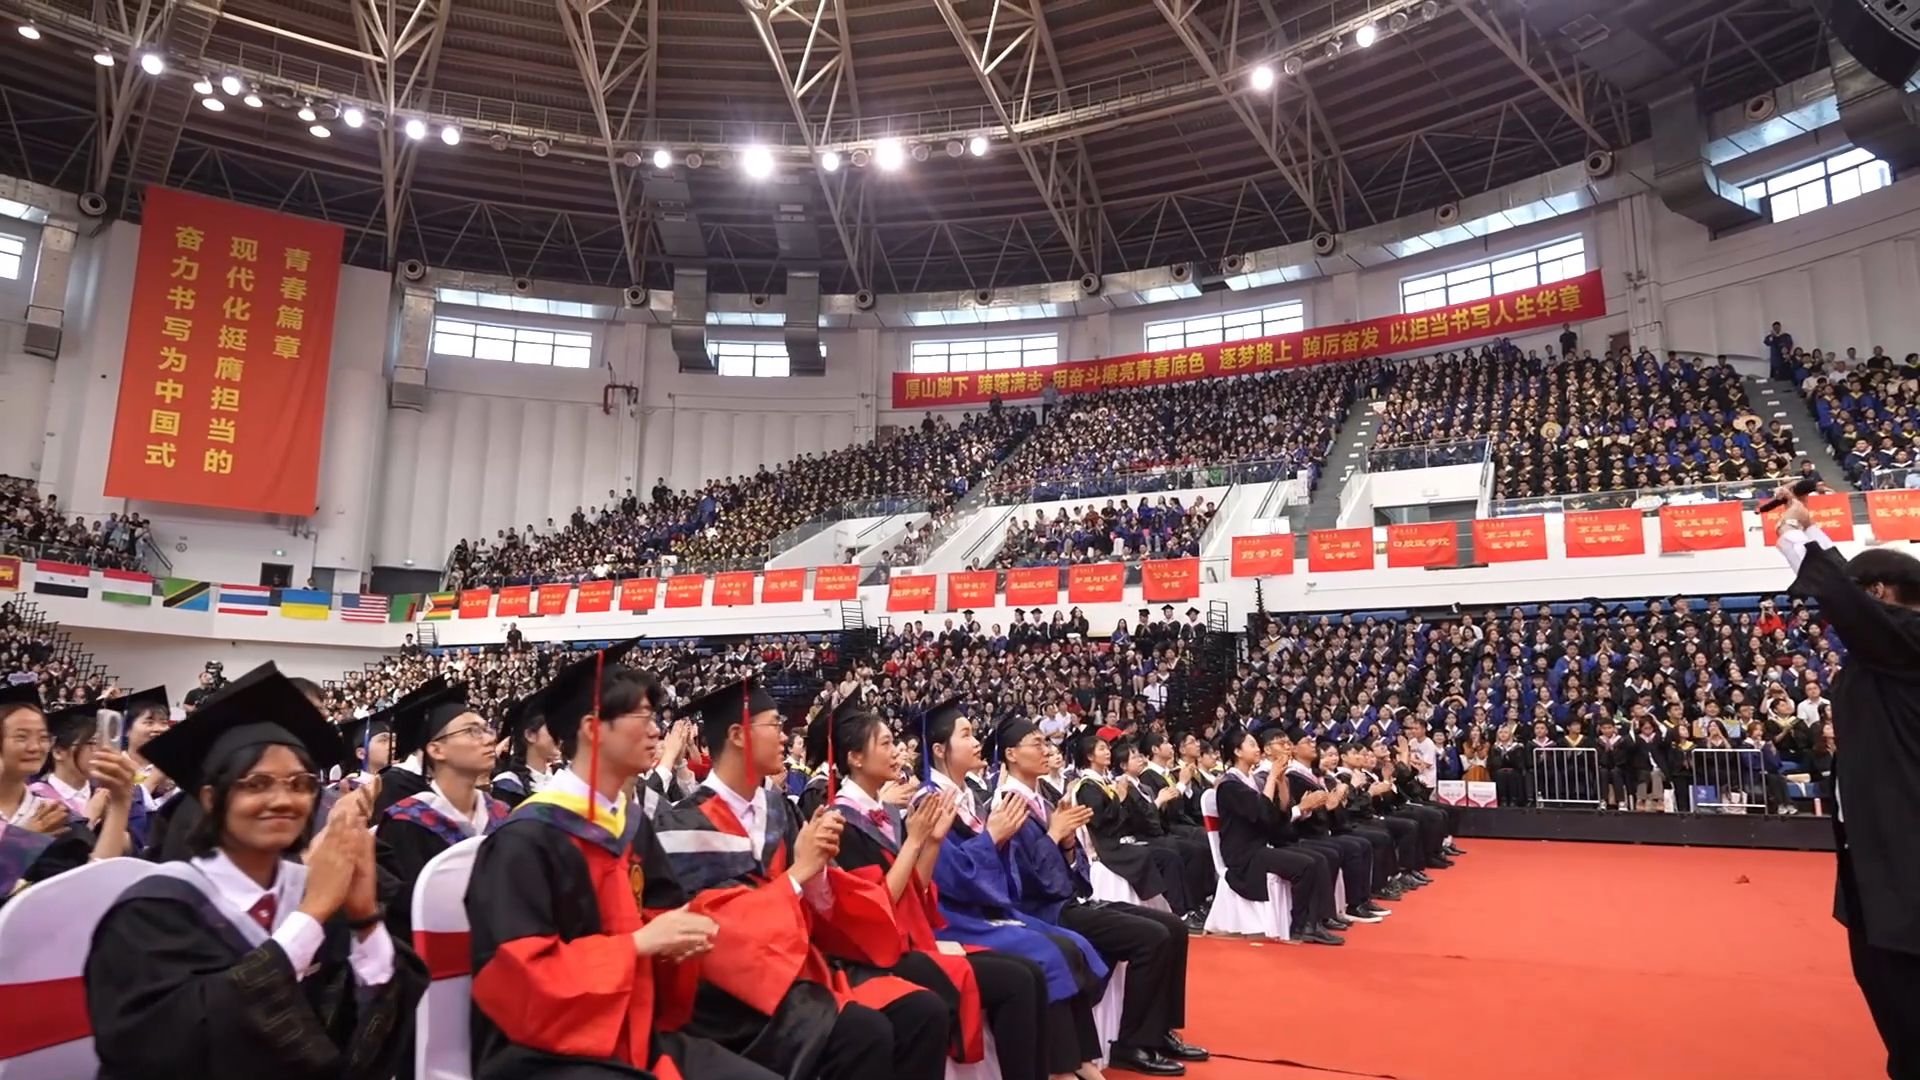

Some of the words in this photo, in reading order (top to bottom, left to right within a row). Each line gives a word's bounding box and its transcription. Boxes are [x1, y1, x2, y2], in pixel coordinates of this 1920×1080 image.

[272, 247, 311, 359] 青春篇章
[1052, 352, 1205, 388] 用奋斗擦亮青春底色
[1219, 340, 1292, 370] 逐梦路上
[1302, 326, 1379, 359] 踔厉奋发
[1390, 285, 1583, 345] 以担当书写人生华章
[145, 226, 204, 468] 奋力书写为中国式
[203, 236, 258, 474] 现代化挺膺担当的
[1485, 528, 1534, 539] 第二临床
[1577, 523, 1631, 534] 第三临床
[1681, 528, 1724, 538] 医学院
[1393, 537, 1450, 549] 口腔医学院
[1491, 540, 1529, 549] 医学院
[1584, 534, 1625, 544] 医学院
[1319, 541, 1362, 551] 第一临床
[1241, 547, 1283, 560] 药学院
[1324, 551, 1357, 560] 医学院
